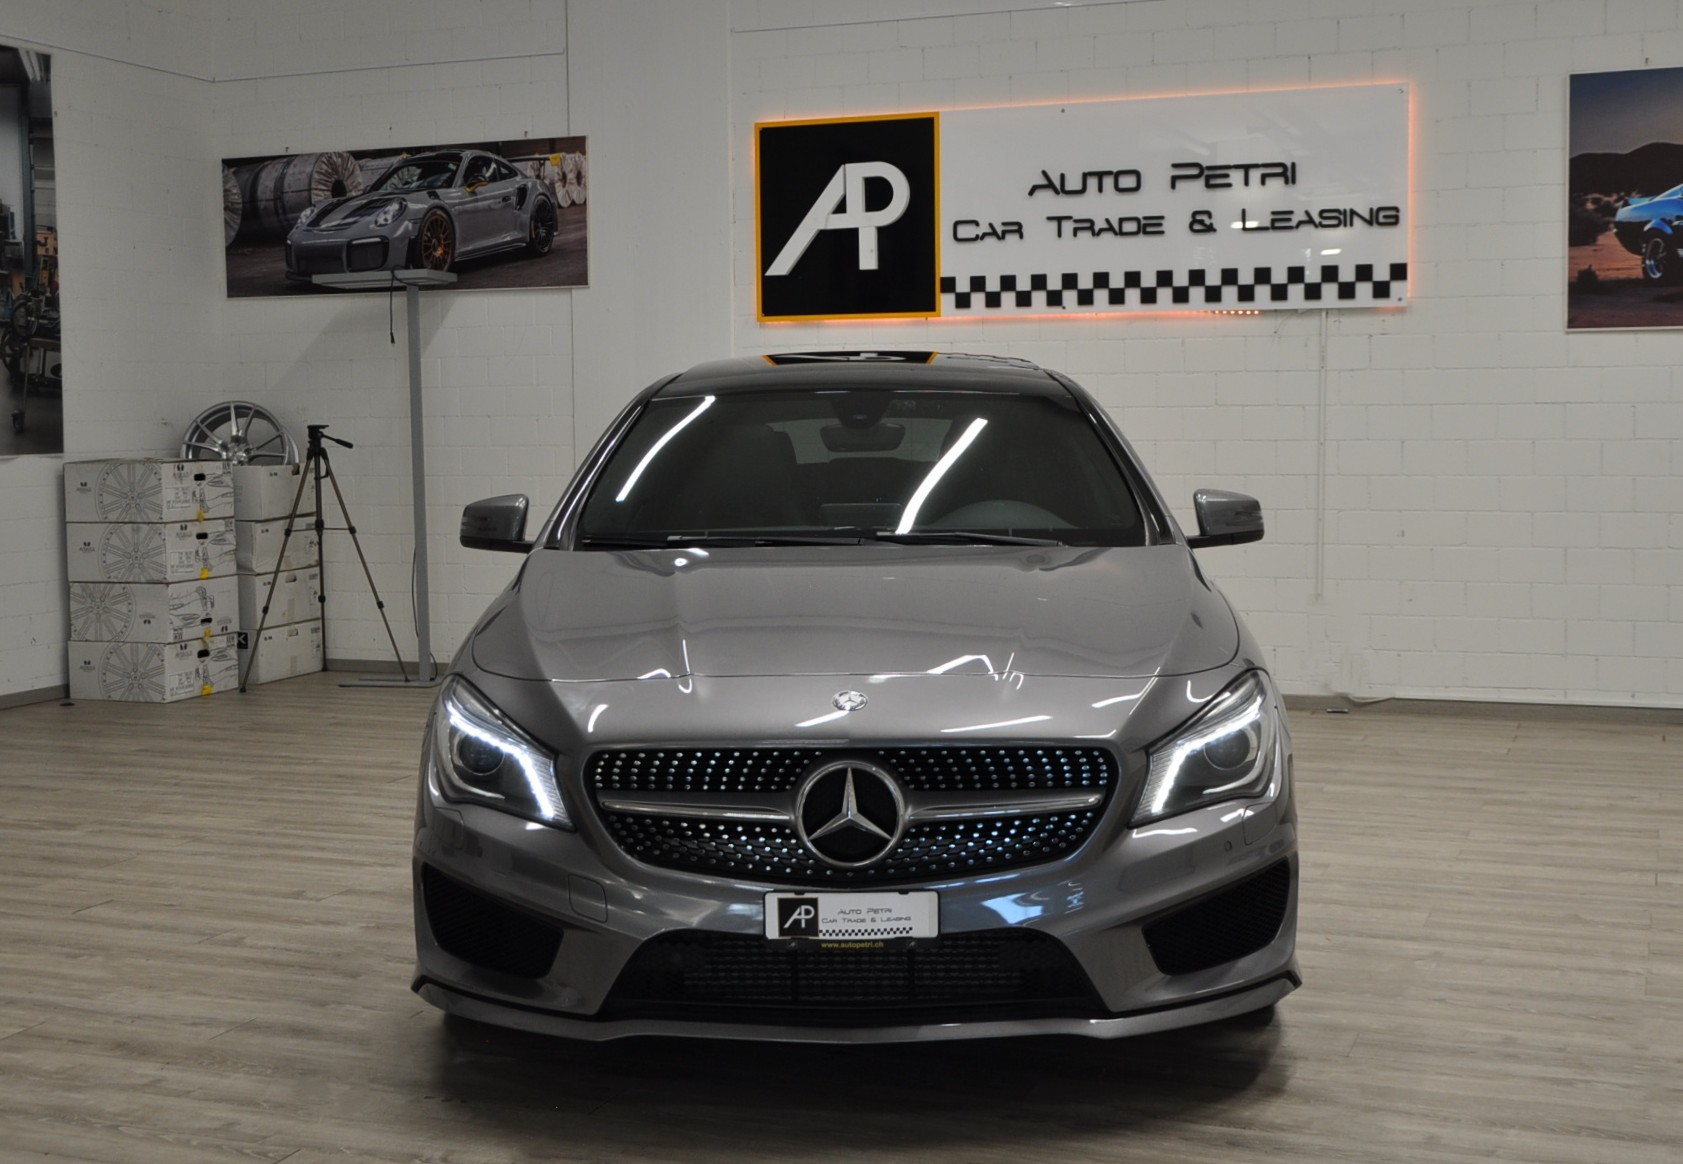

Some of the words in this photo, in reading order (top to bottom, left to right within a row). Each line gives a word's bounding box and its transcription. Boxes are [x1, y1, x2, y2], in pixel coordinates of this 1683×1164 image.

[1027, 169, 1142, 197] AUTO
[1170, 161, 1297, 190] PETRI
[764, 160, 911, 276] AP
[952, 219, 1024, 242] CAR
[1046, 215, 1166, 239] TRADE
[1188, 210, 1217, 234] &
[1241, 205, 1401, 232] LEASING
[784, 905, 815, 928] AP
